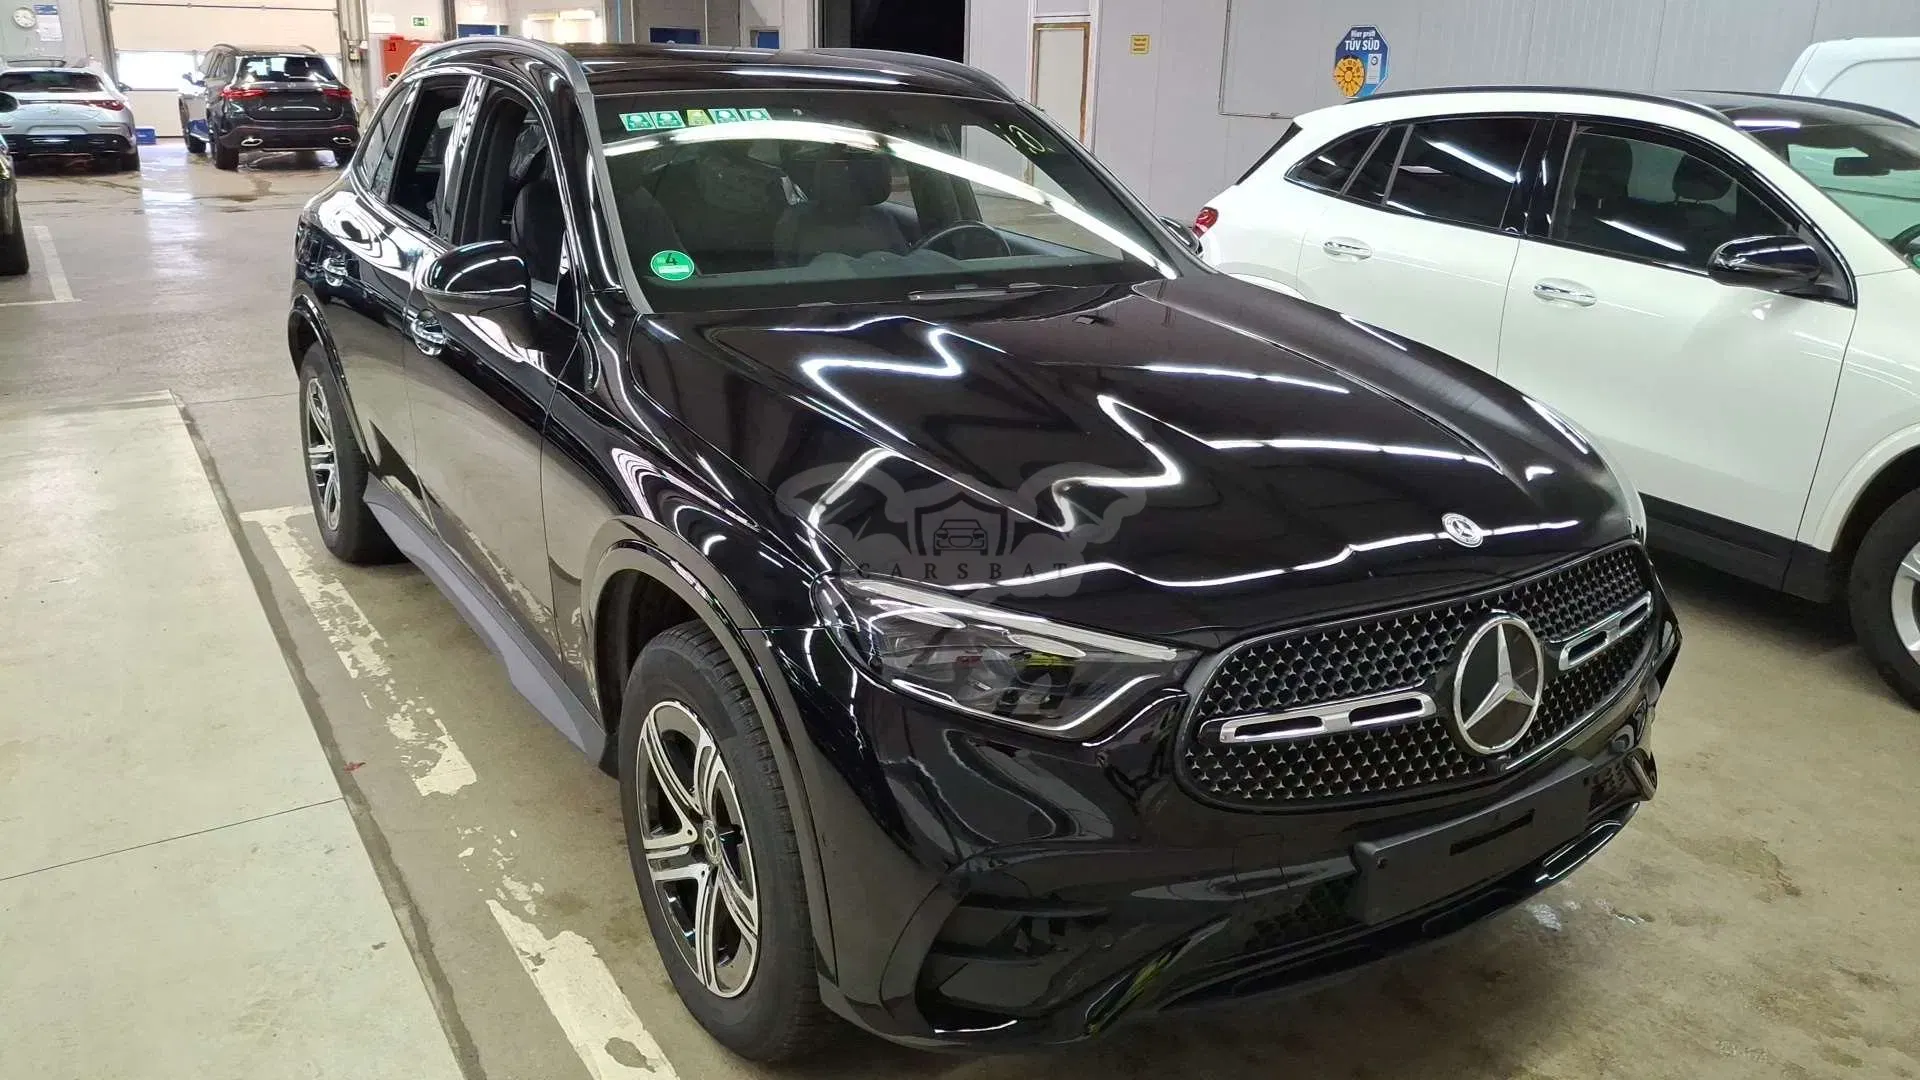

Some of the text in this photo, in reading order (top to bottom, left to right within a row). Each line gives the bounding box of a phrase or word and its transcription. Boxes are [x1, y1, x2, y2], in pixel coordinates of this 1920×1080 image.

[1345, 38, 1380, 51] TÜV SÜD
[666, 252, 679, 265] 4
